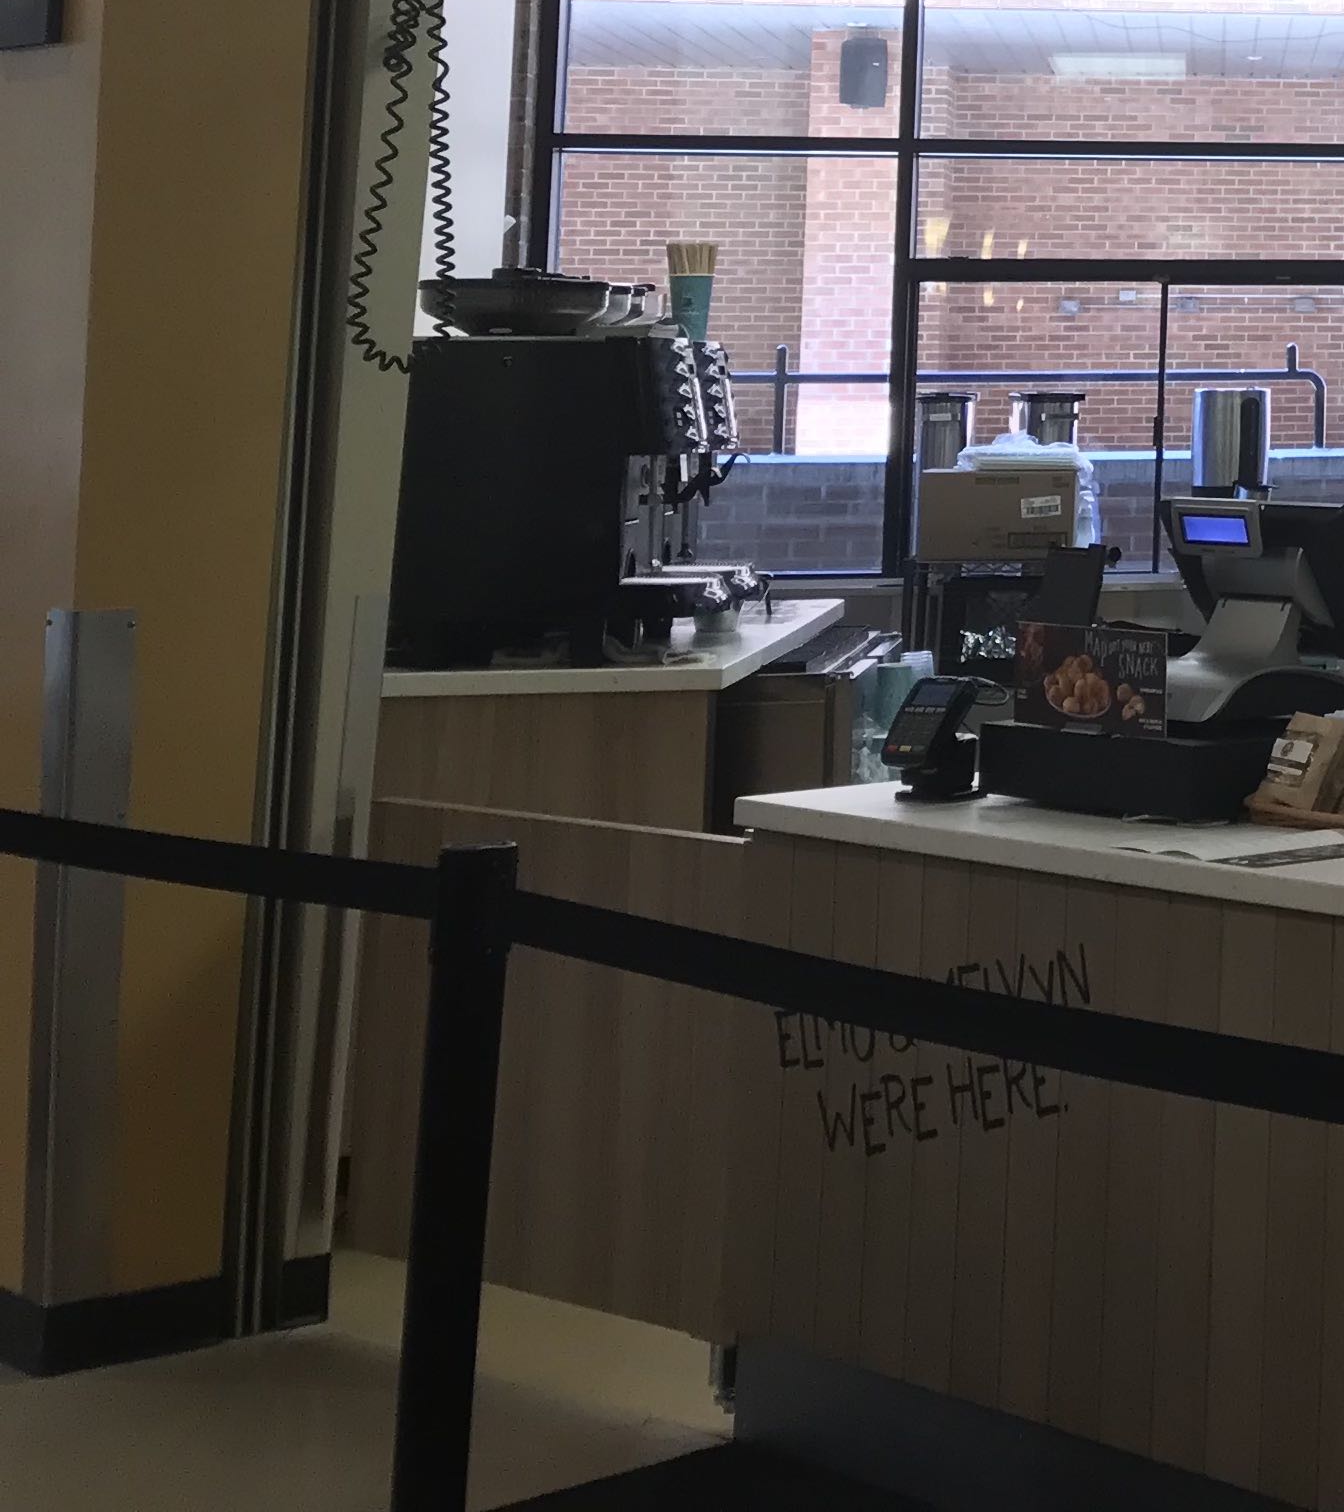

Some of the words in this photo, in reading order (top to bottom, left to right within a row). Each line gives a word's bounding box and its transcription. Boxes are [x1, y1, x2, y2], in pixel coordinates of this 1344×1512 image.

[1118, 653, 1159, 679] SNACK
[817, 1073, 938, 1157] WERE
[947, 1055, 1069, 1132] HERE.
